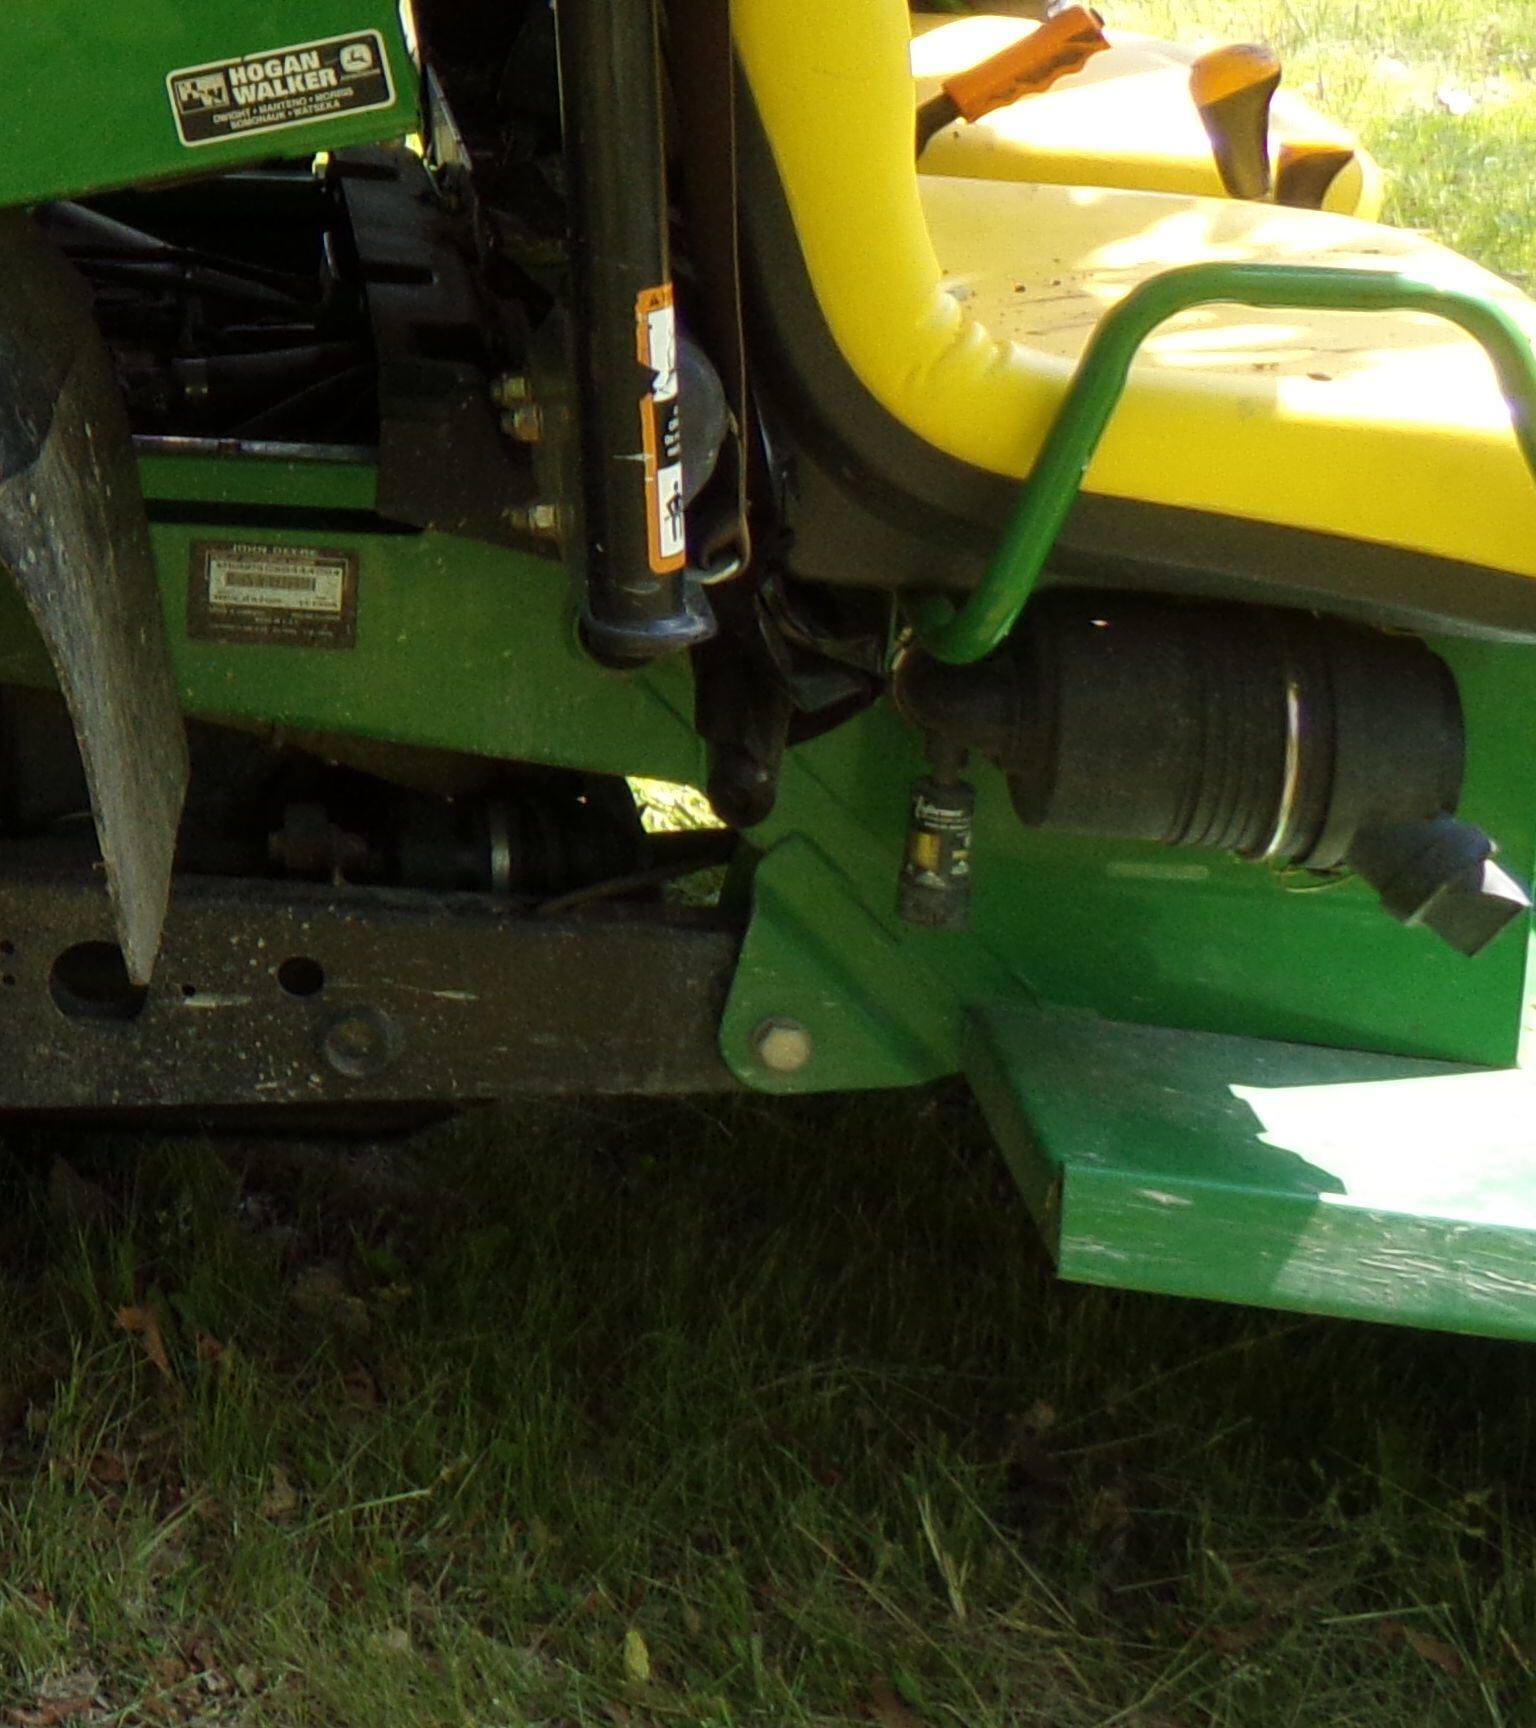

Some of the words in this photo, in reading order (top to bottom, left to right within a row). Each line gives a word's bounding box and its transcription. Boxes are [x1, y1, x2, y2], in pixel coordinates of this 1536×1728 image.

[228, 50, 321, 87] HOGAN
[231, 68, 338, 106] WALKER
[259, 96, 308, 114] MANTENO
[293, 99, 342, 118] WATSEKA
